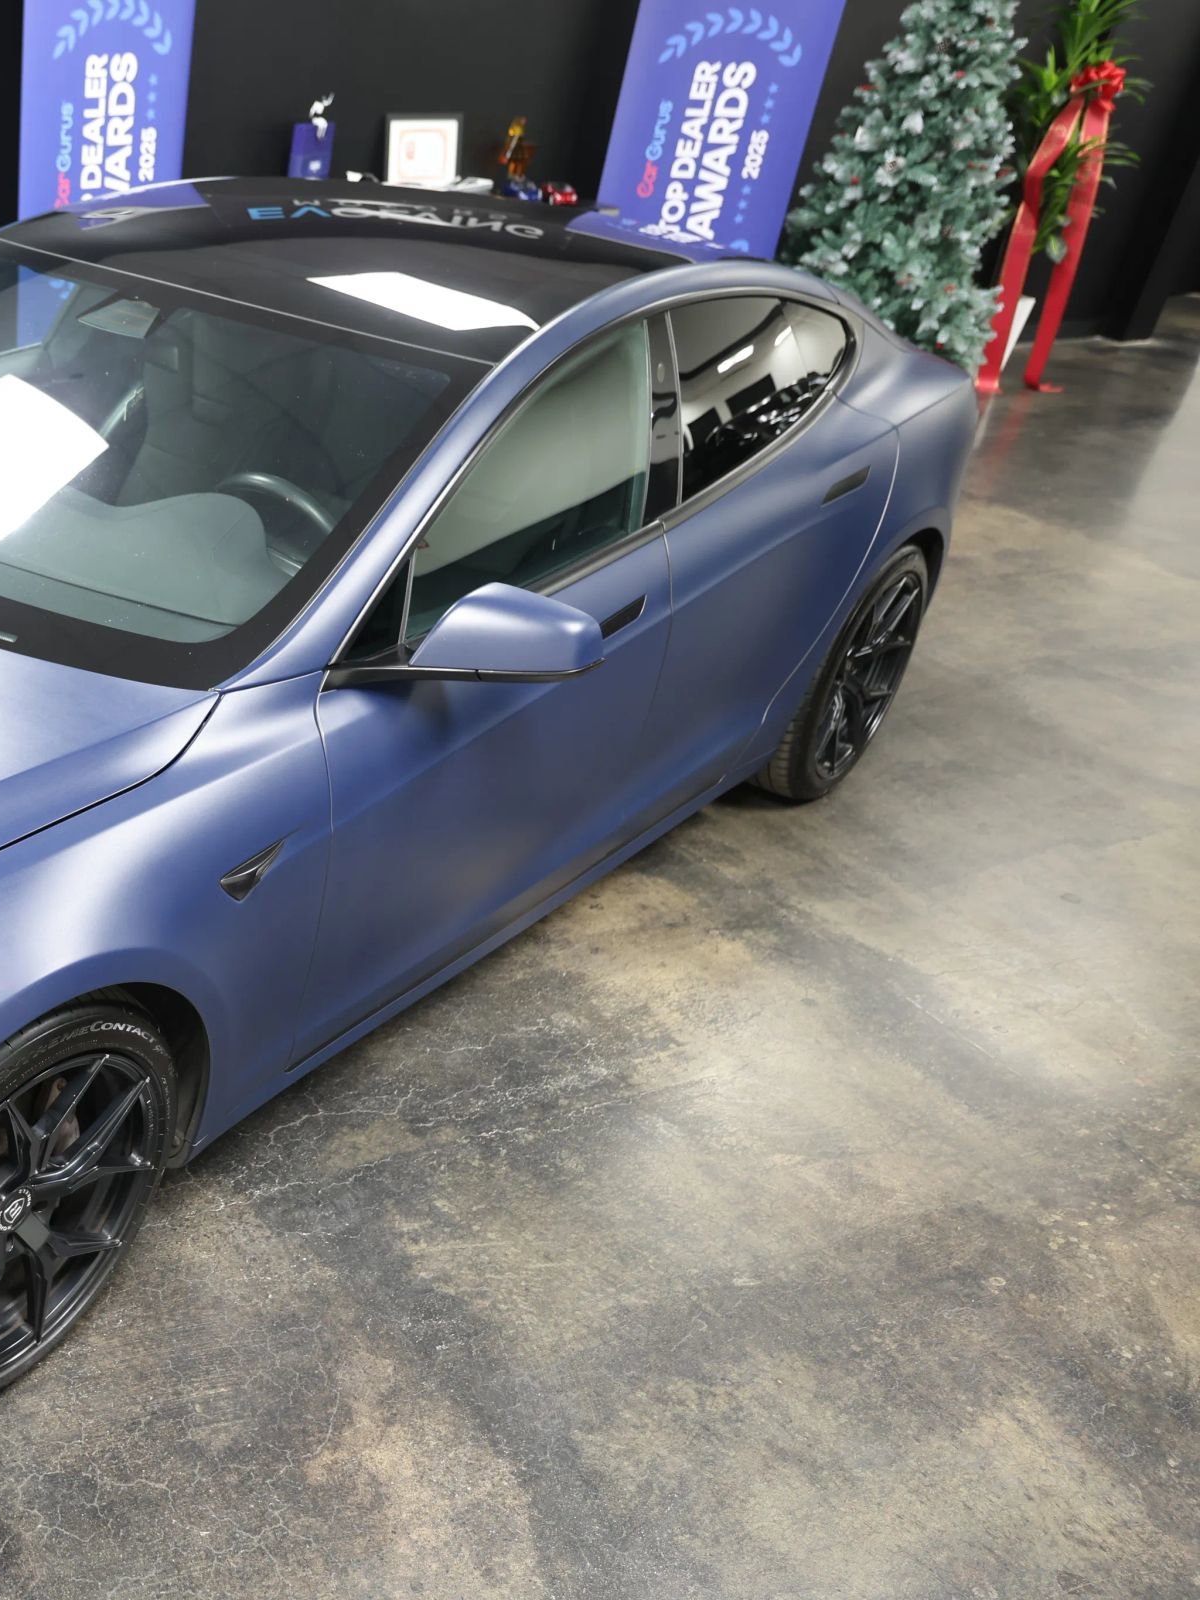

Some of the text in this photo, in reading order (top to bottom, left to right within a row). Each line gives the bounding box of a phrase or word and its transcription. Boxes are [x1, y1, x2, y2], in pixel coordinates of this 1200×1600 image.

[80, 53, 109, 190] DEALER
[138, 126, 157, 182] 2025
[636, 100, 673, 198] CarGurus
[659, 61, 722, 234] TOP DEALER
[685, 61, 757, 241] AWARDS
[741, 129, 770, 181] 2025
